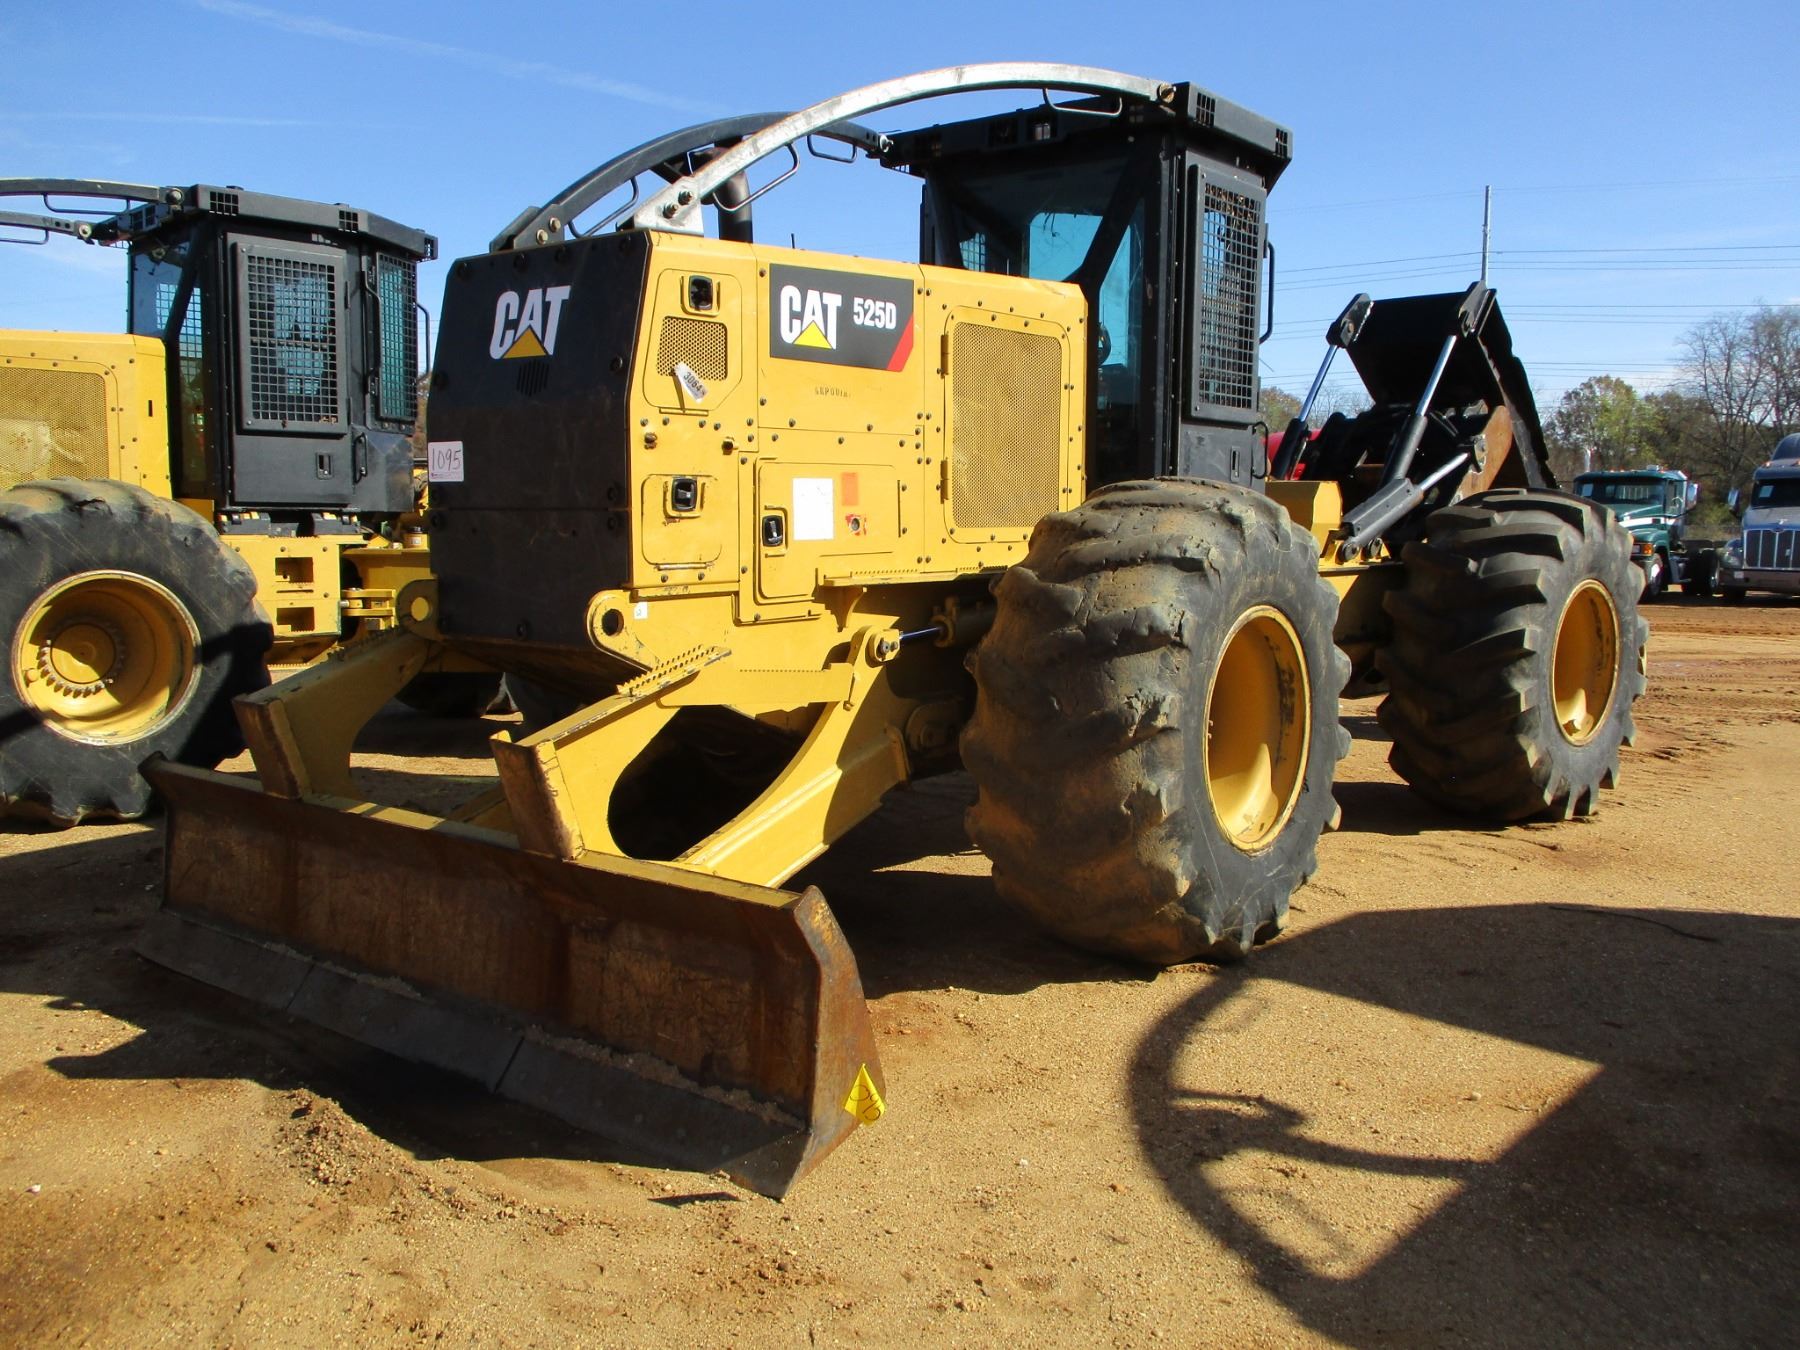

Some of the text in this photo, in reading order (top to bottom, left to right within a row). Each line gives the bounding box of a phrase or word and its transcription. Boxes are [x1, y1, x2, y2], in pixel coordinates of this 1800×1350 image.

[489, 285, 571, 360] CAT
[780, 285, 897, 350] CAT 525D
[431, 447, 462, 472] 1095
